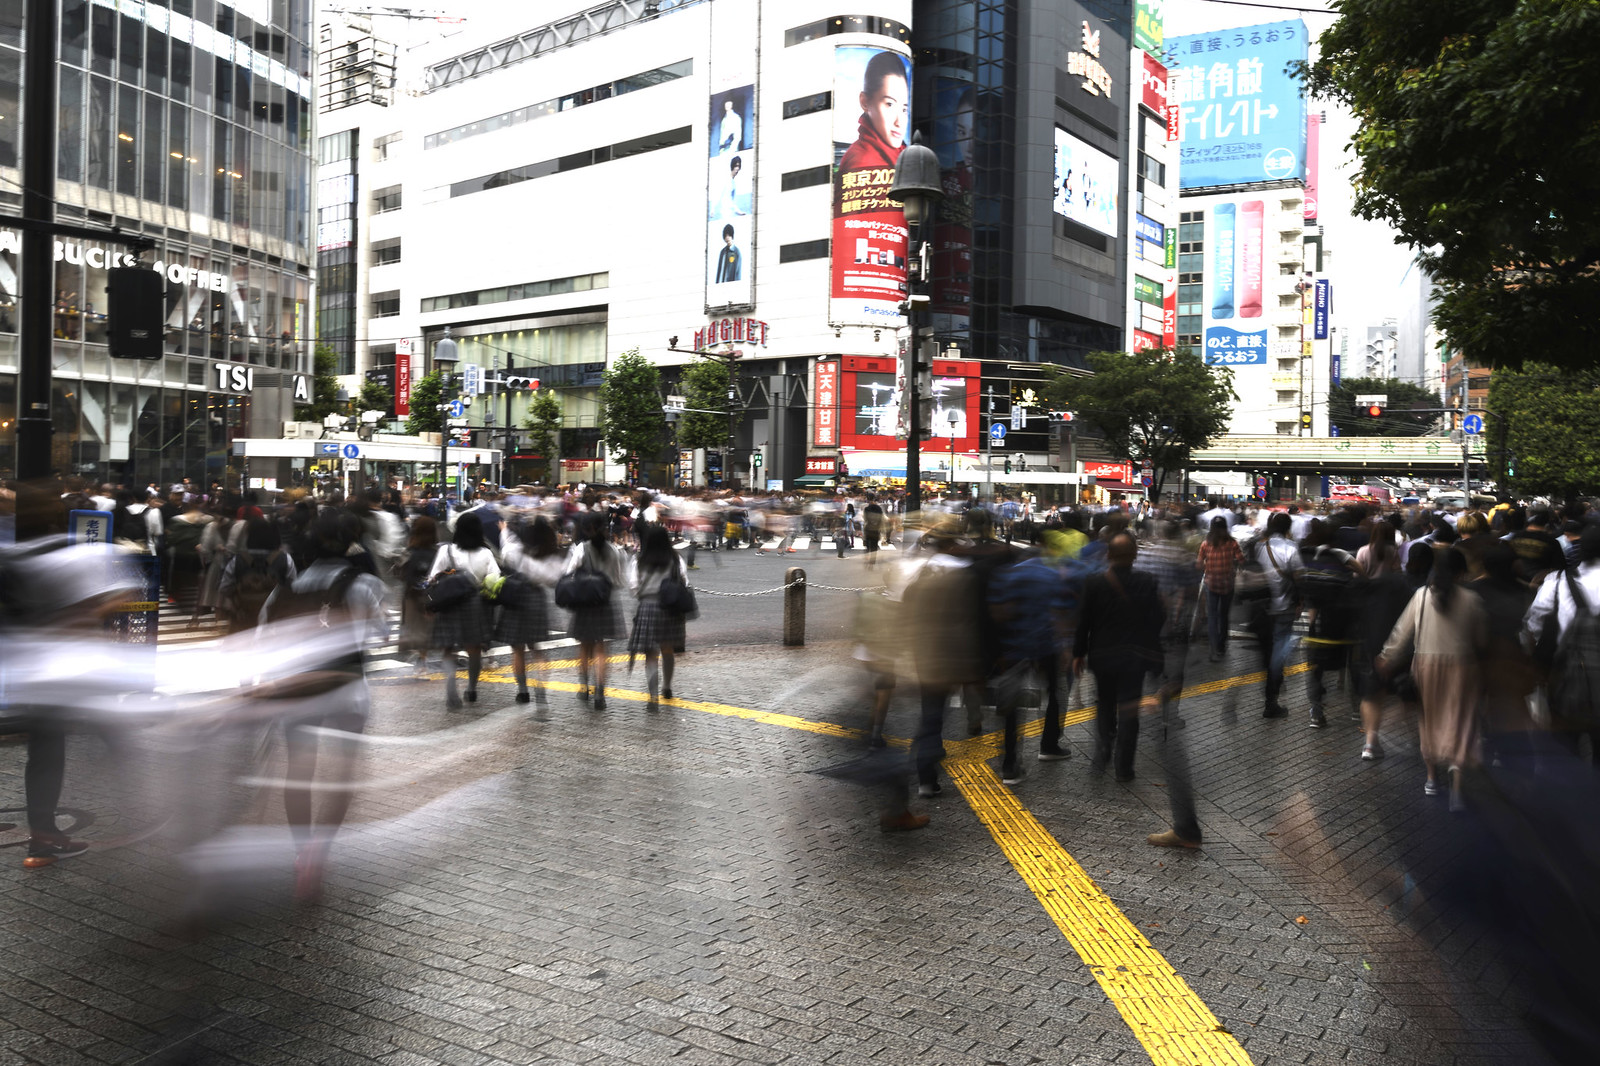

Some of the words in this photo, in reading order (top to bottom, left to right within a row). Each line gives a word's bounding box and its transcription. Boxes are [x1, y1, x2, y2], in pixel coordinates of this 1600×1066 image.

[841, 168, 897, 190] 東京202
[1164, 310, 1174, 333] アコム
[694, 318, 769, 352] MAGNET
[1207, 335, 1267, 349] のど、直接、
[1213, 351, 1258, 363] うるおう
[818, 374, 833, 443] 天津甘栗
[806, 461, 835, 471] 天津甘栗
